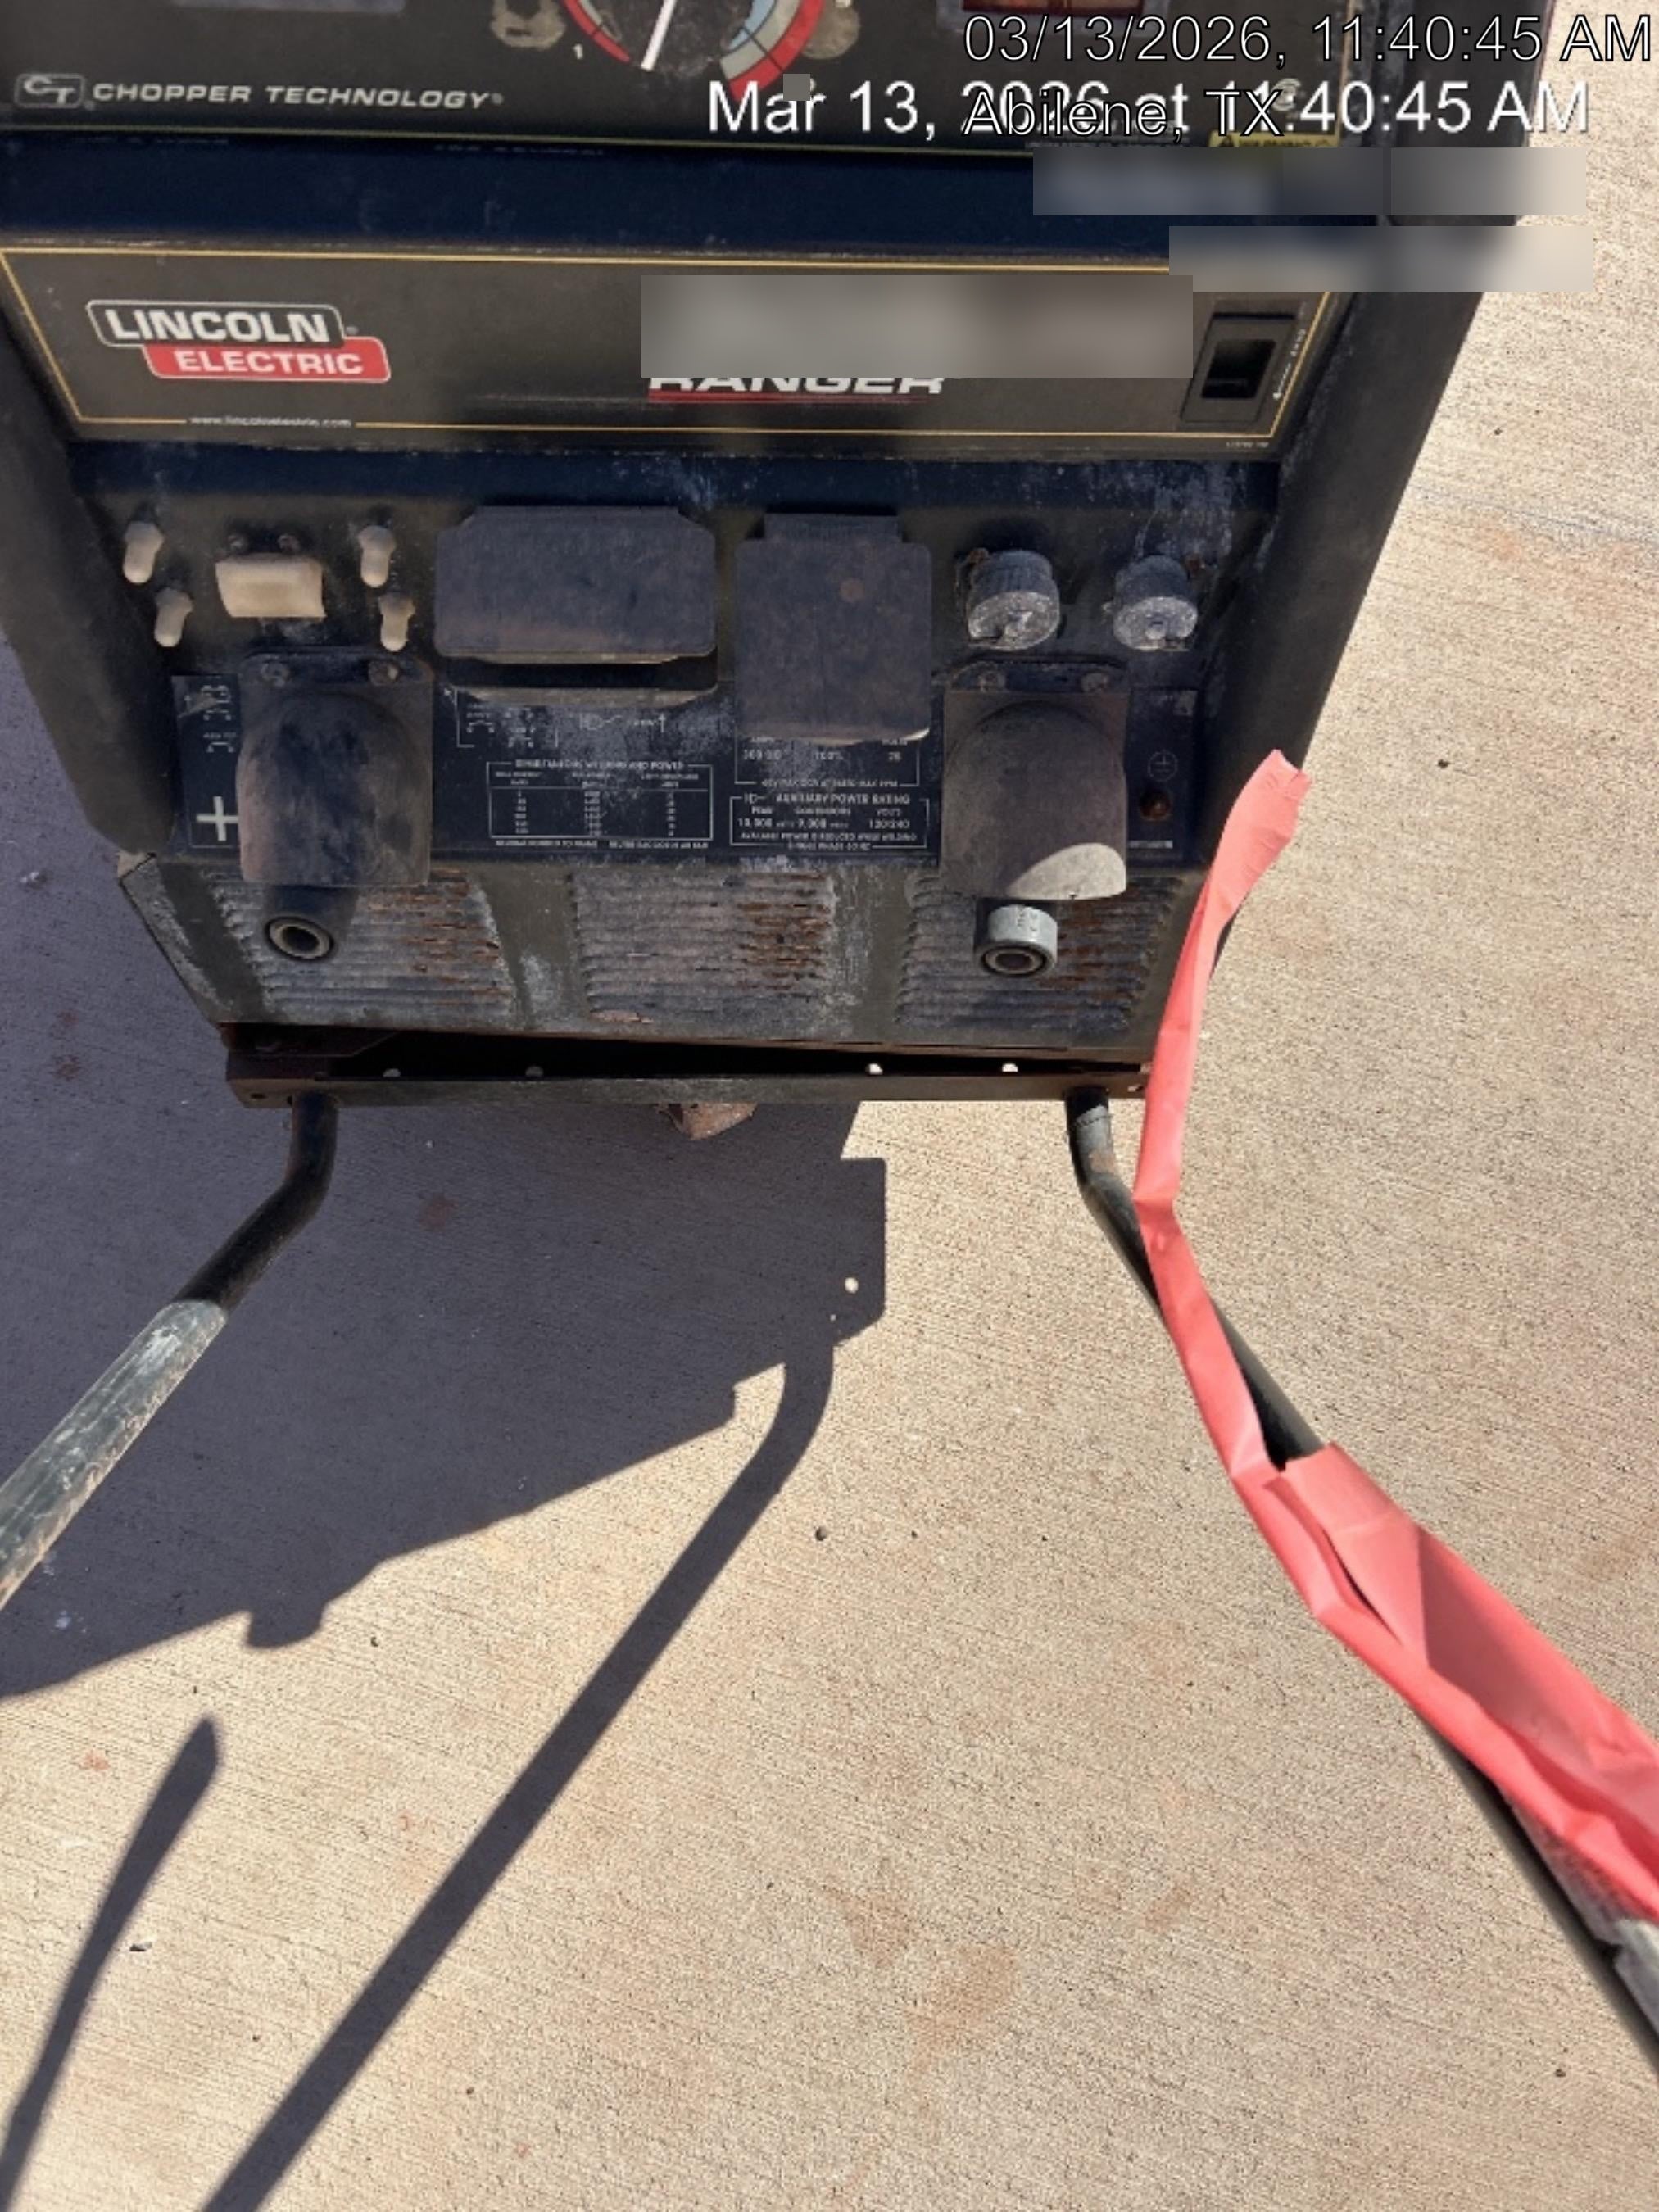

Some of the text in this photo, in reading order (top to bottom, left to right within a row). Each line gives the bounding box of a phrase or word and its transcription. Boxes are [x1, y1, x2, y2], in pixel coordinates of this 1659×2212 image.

[93, 83, 252, 102] CHOPPER
[105, 309, 329, 342] LINCOLN
[174, 351, 363, 374] ELECTRIC
